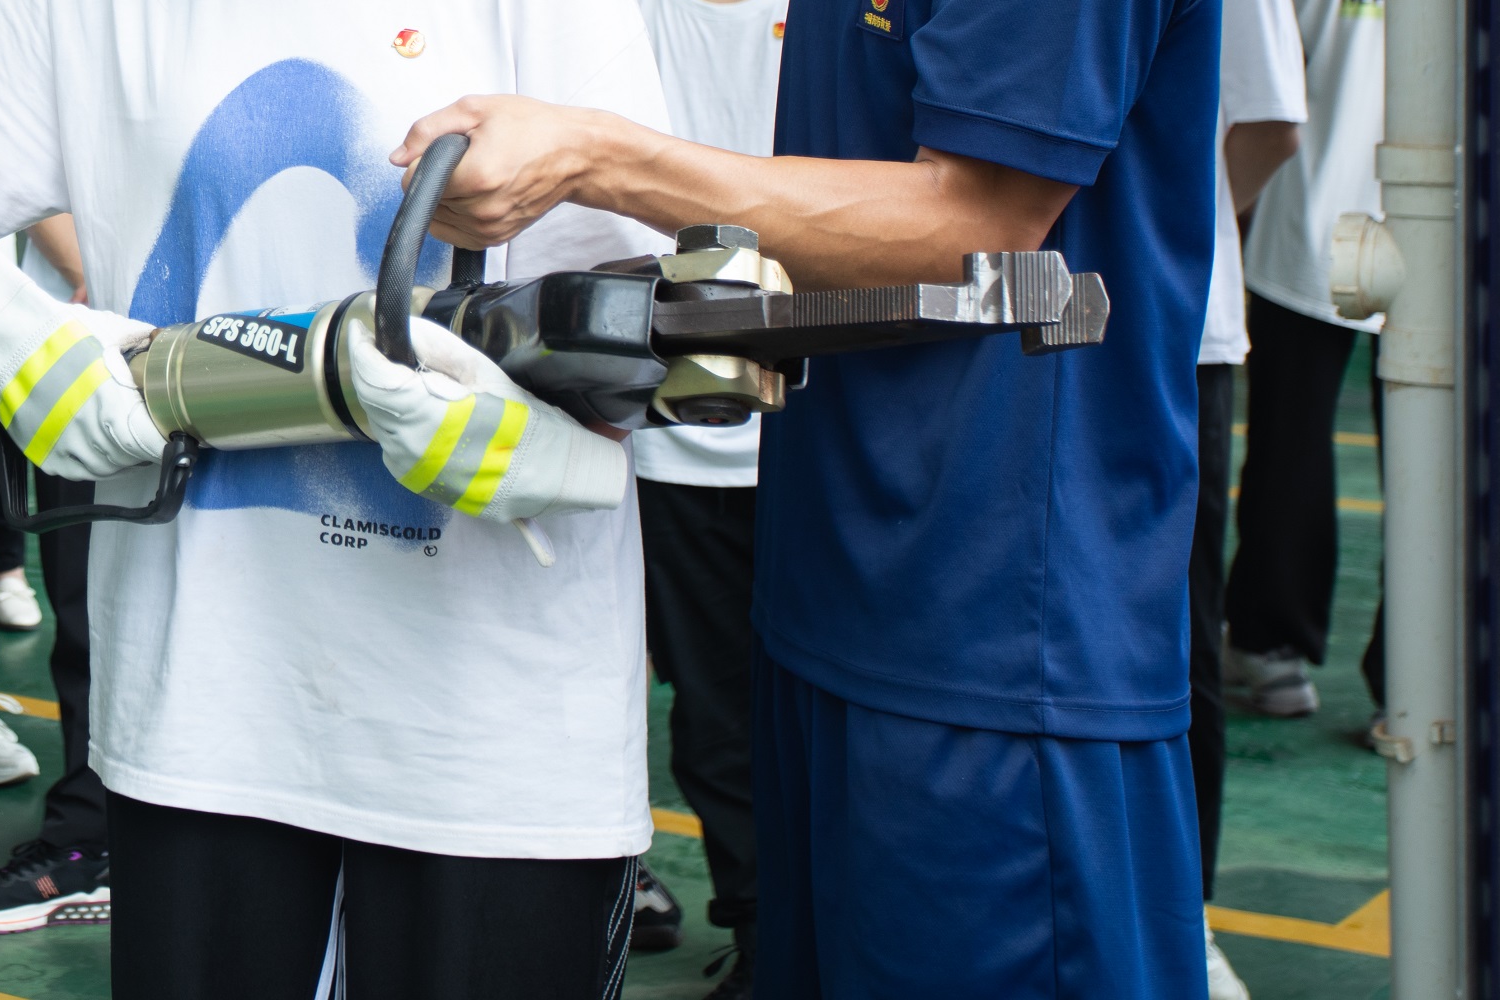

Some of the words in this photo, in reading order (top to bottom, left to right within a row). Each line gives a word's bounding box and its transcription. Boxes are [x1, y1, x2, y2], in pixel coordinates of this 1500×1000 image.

[203, 316, 245, 342] SPS
[240, 321, 299, 365] 360-L
[319, 531, 369, 550] CORP
[320, 513, 442, 541] CLAMISGOLD
